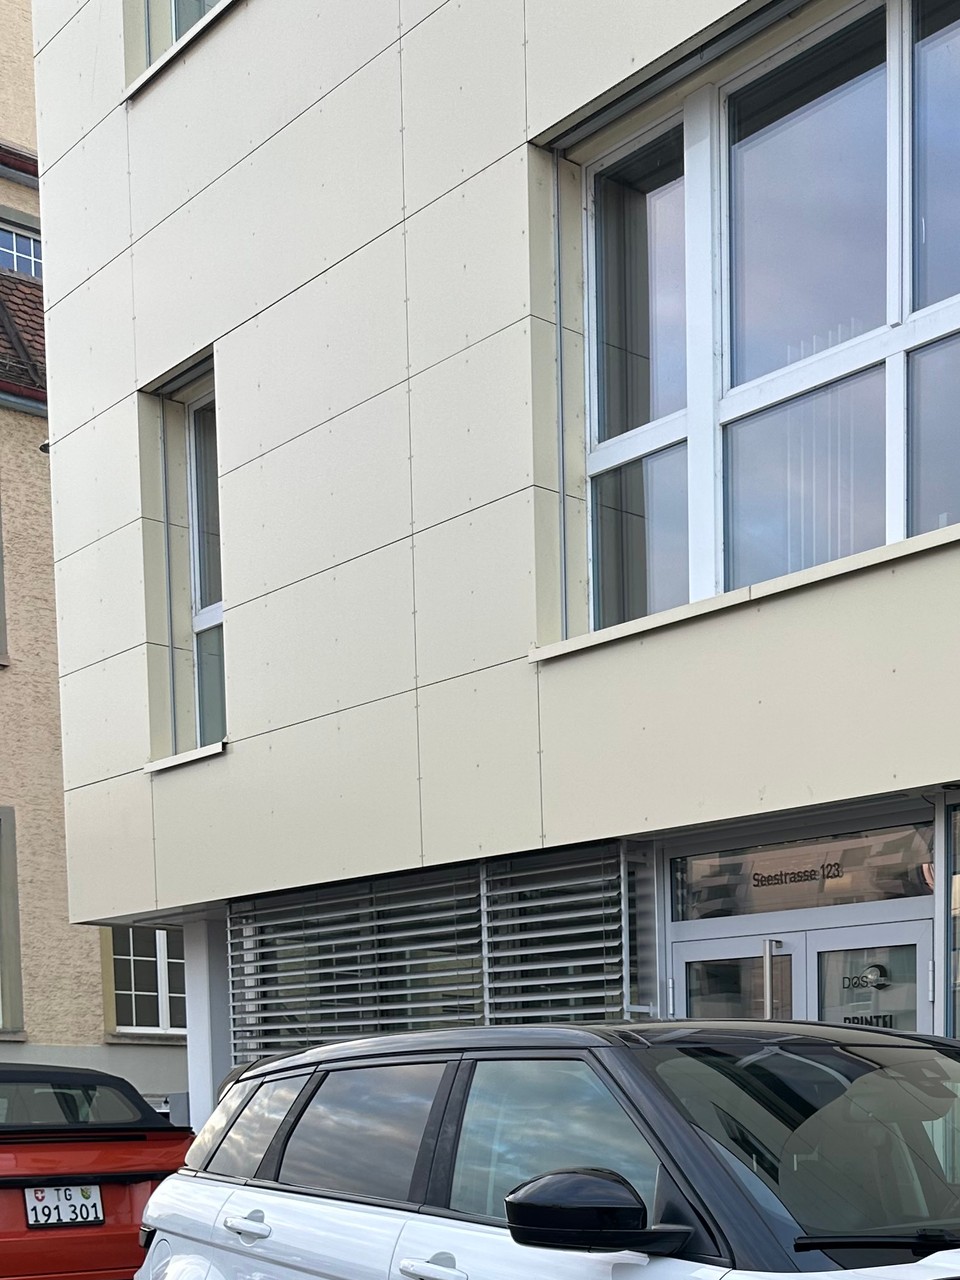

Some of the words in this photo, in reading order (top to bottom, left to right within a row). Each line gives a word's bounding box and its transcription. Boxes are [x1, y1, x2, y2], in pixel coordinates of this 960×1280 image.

[753, 866, 817, 888] Seestrasse
[820, 862, 840, 880] 123
[54, 1188, 72, 1201] TG
[31, 1204, 63, 1223] 191
[69, 1202, 101, 1221] 301
